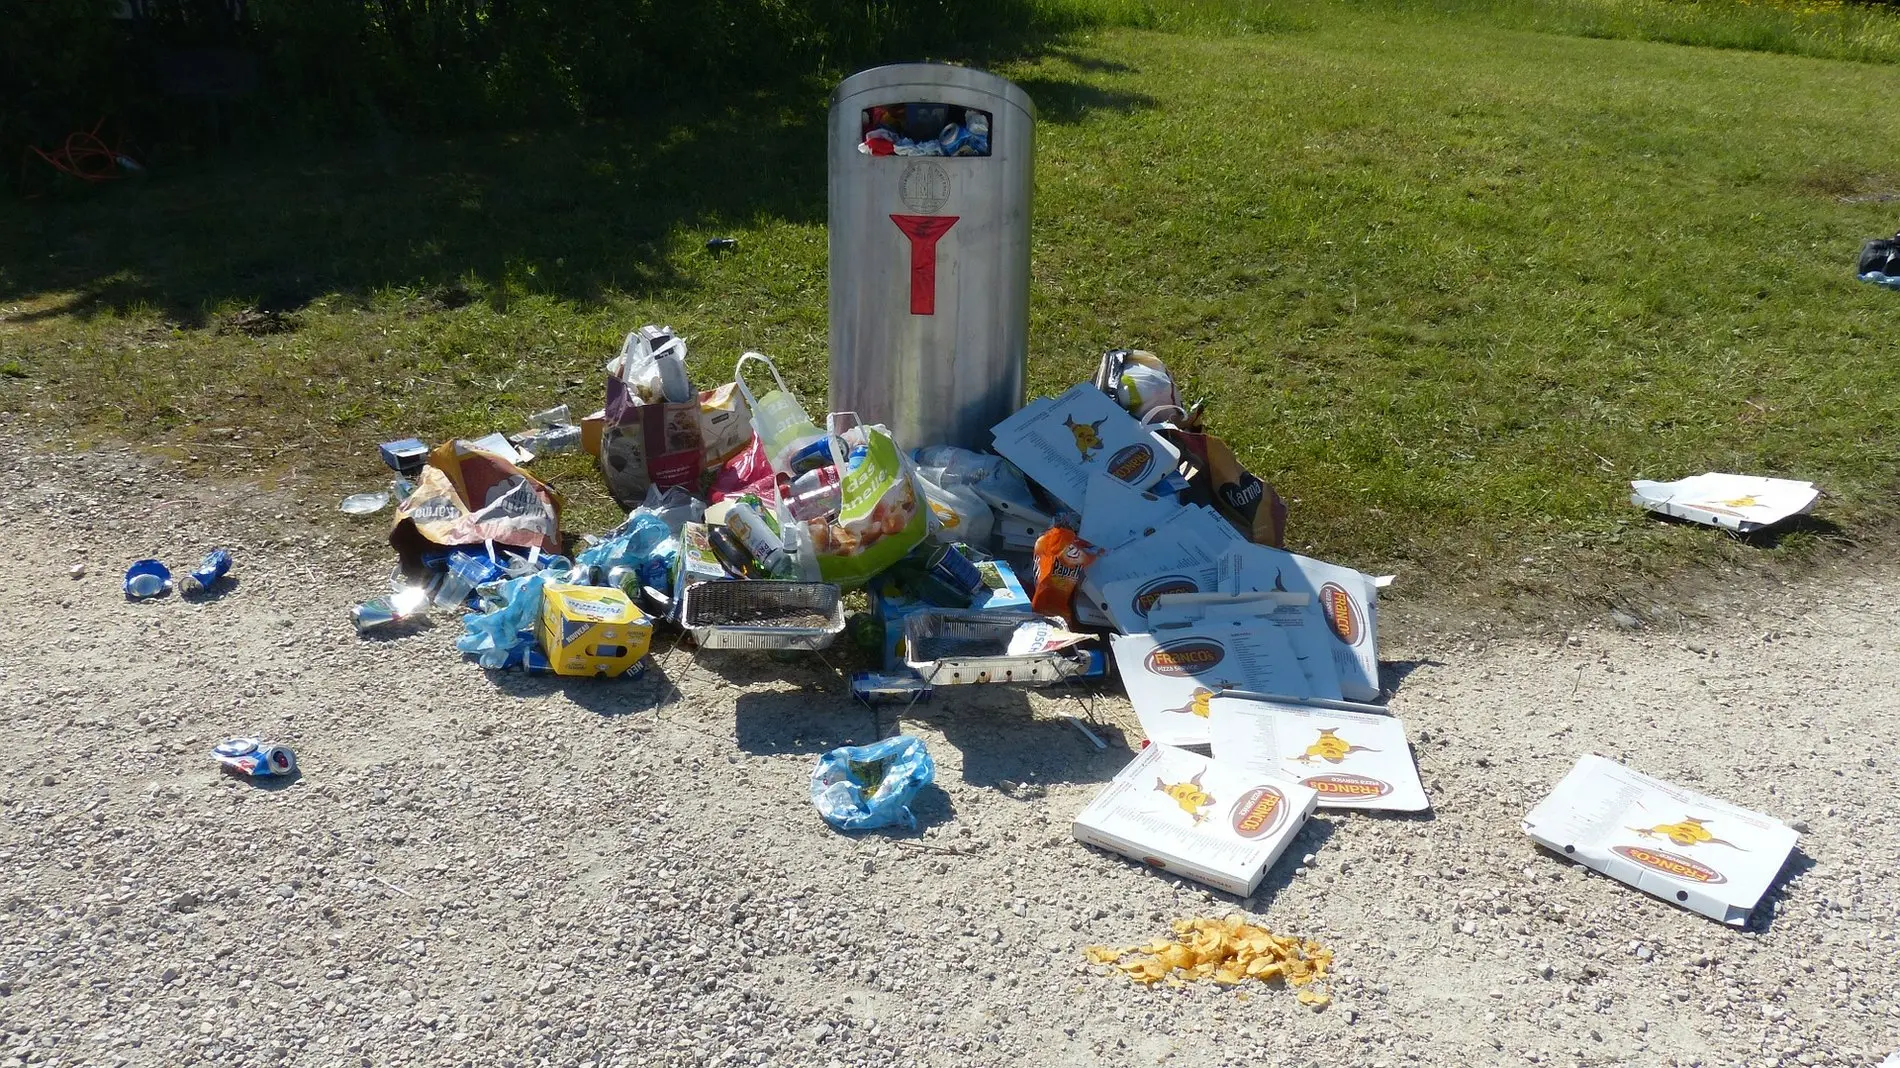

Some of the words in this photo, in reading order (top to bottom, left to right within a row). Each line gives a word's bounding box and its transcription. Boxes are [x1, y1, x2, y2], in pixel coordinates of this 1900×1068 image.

[847, 462, 875, 493] das
[1225, 481, 1261, 507] Karma
[414, 503, 456, 519] Karma
[565, 623, 590, 643] NOUVEAU
[626, 660, 645, 677] NEU
